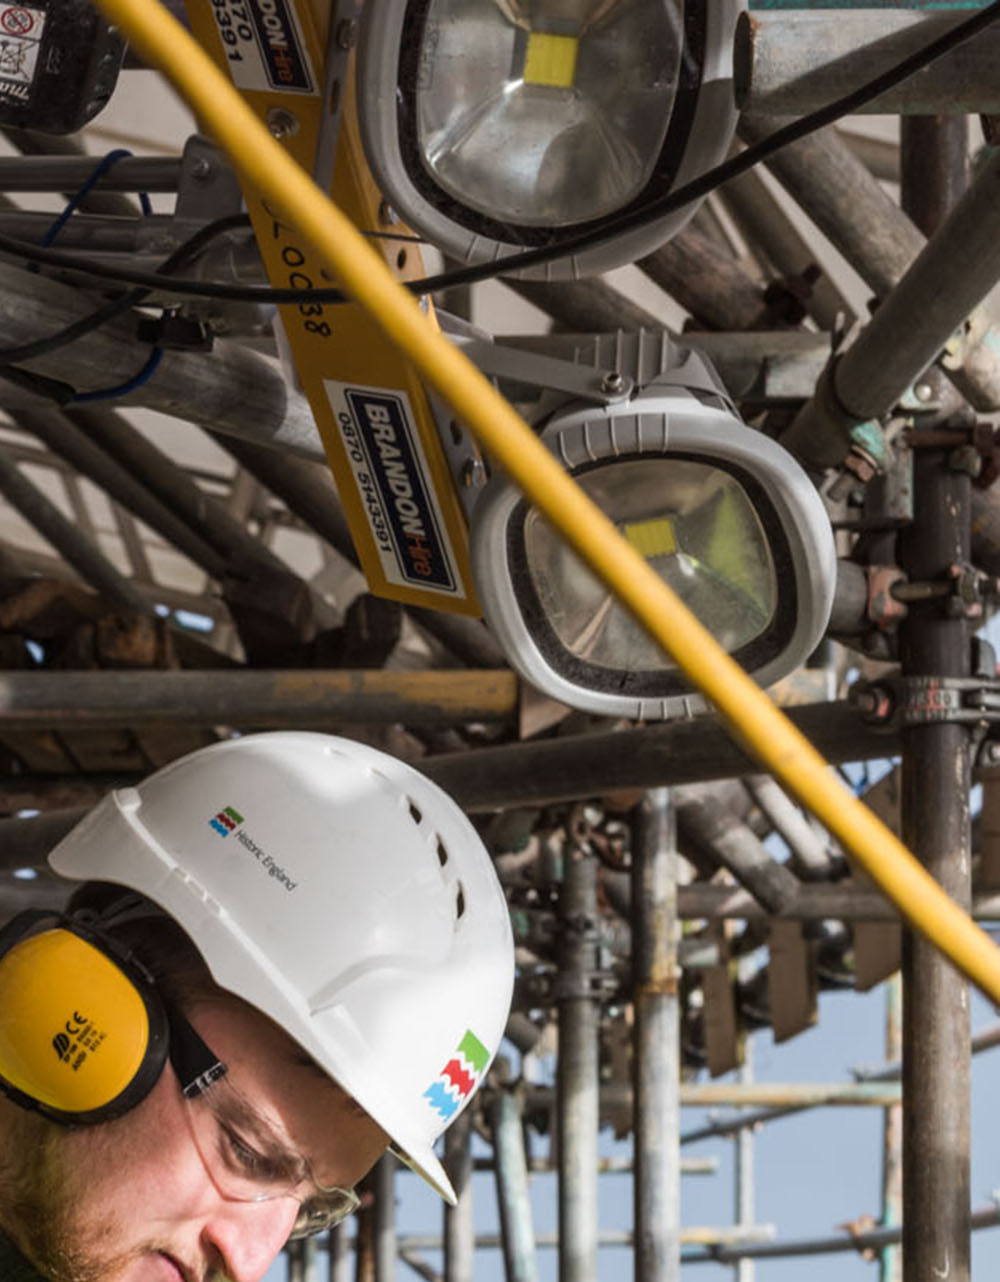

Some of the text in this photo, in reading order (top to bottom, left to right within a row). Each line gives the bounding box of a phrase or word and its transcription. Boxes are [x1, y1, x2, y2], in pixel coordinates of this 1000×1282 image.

[338, 411, 393, 553] 0870 5143391
[234, 829, 299, 892] Historic England
